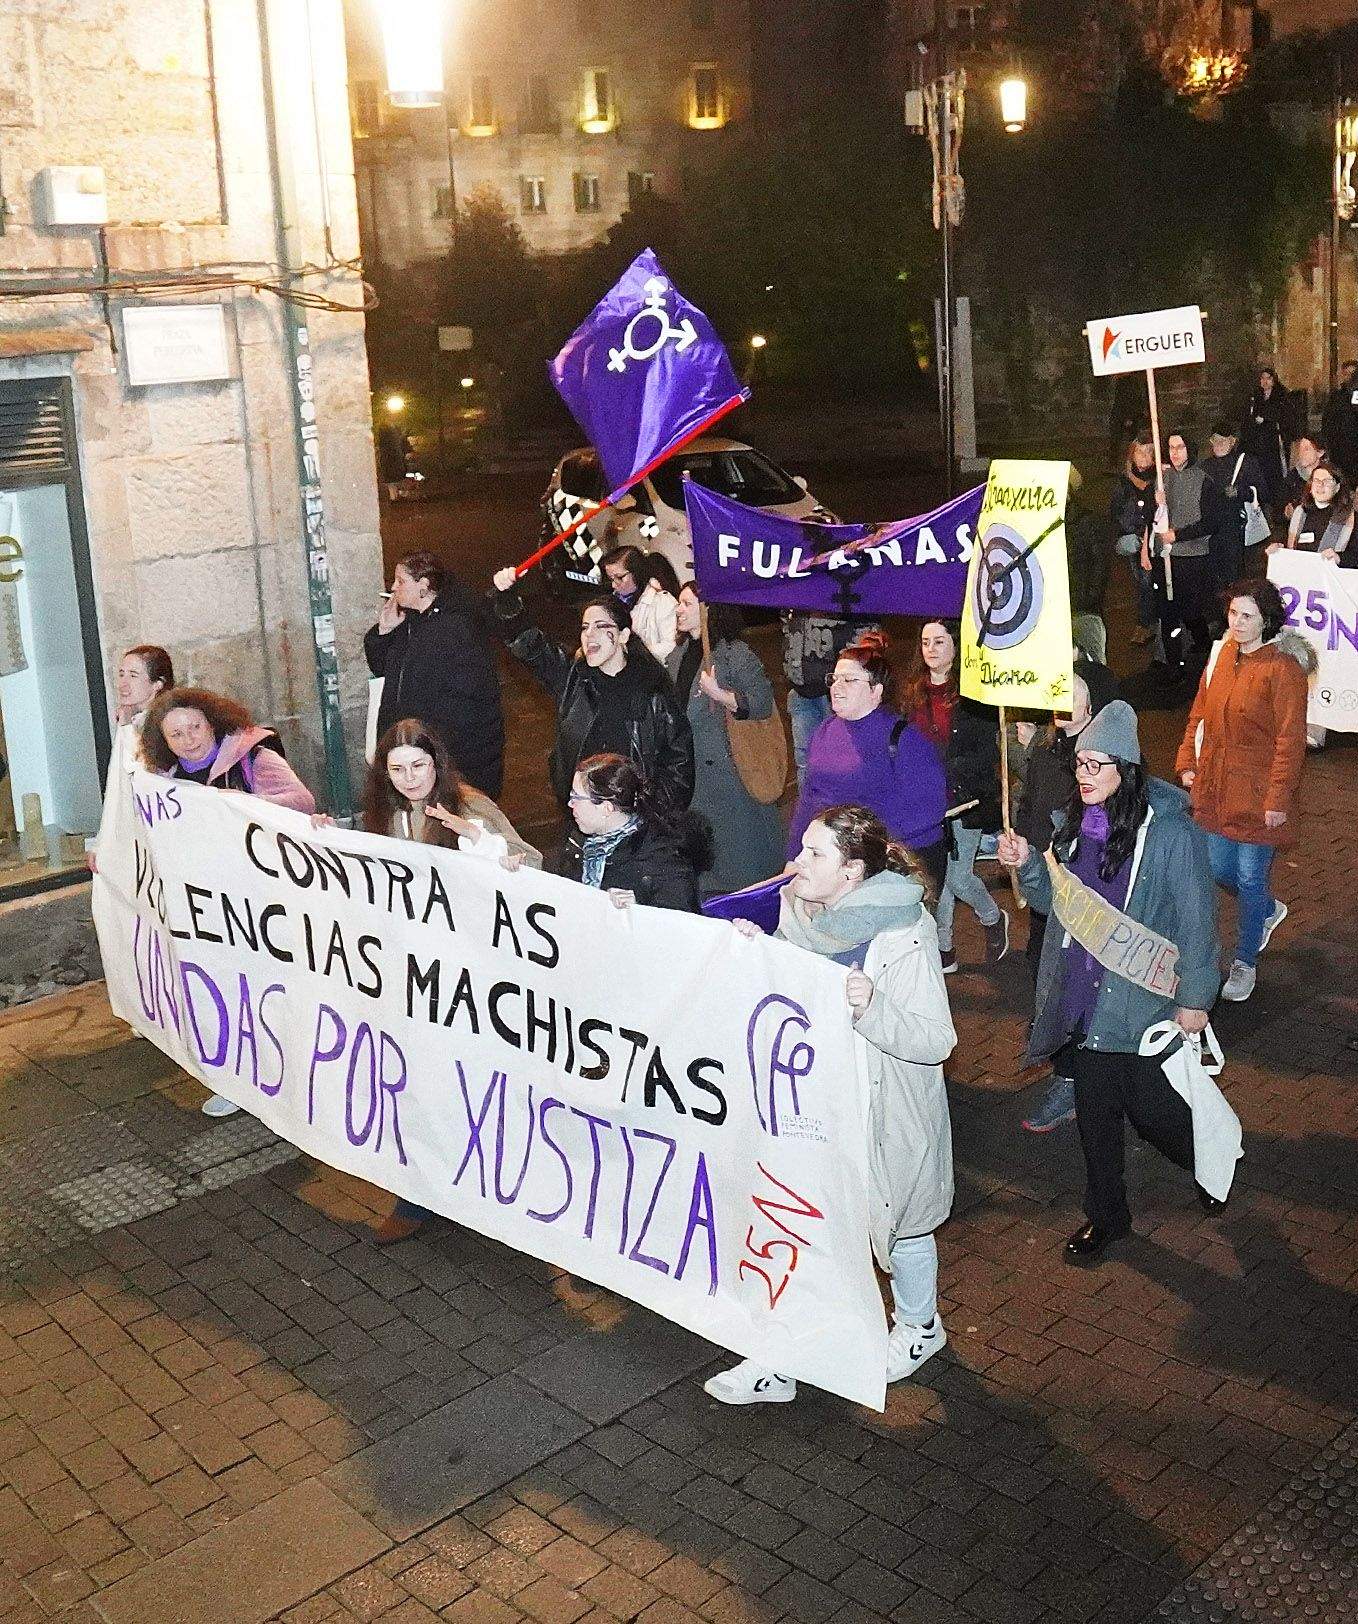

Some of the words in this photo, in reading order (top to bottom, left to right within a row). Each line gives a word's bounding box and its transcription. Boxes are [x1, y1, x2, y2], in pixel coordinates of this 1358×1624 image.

[1125, 332, 1195, 354] ERGUER
[245, 822, 456, 932] CONTRA
[492, 889, 559, 969] AS
[406, 953, 728, 1126] MACHISTAS
[308, 1003, 408, 1166] POR
[452, 1060, 718, 1297] XUSTIZA
[739, 1161, 824, 1310] 25N
